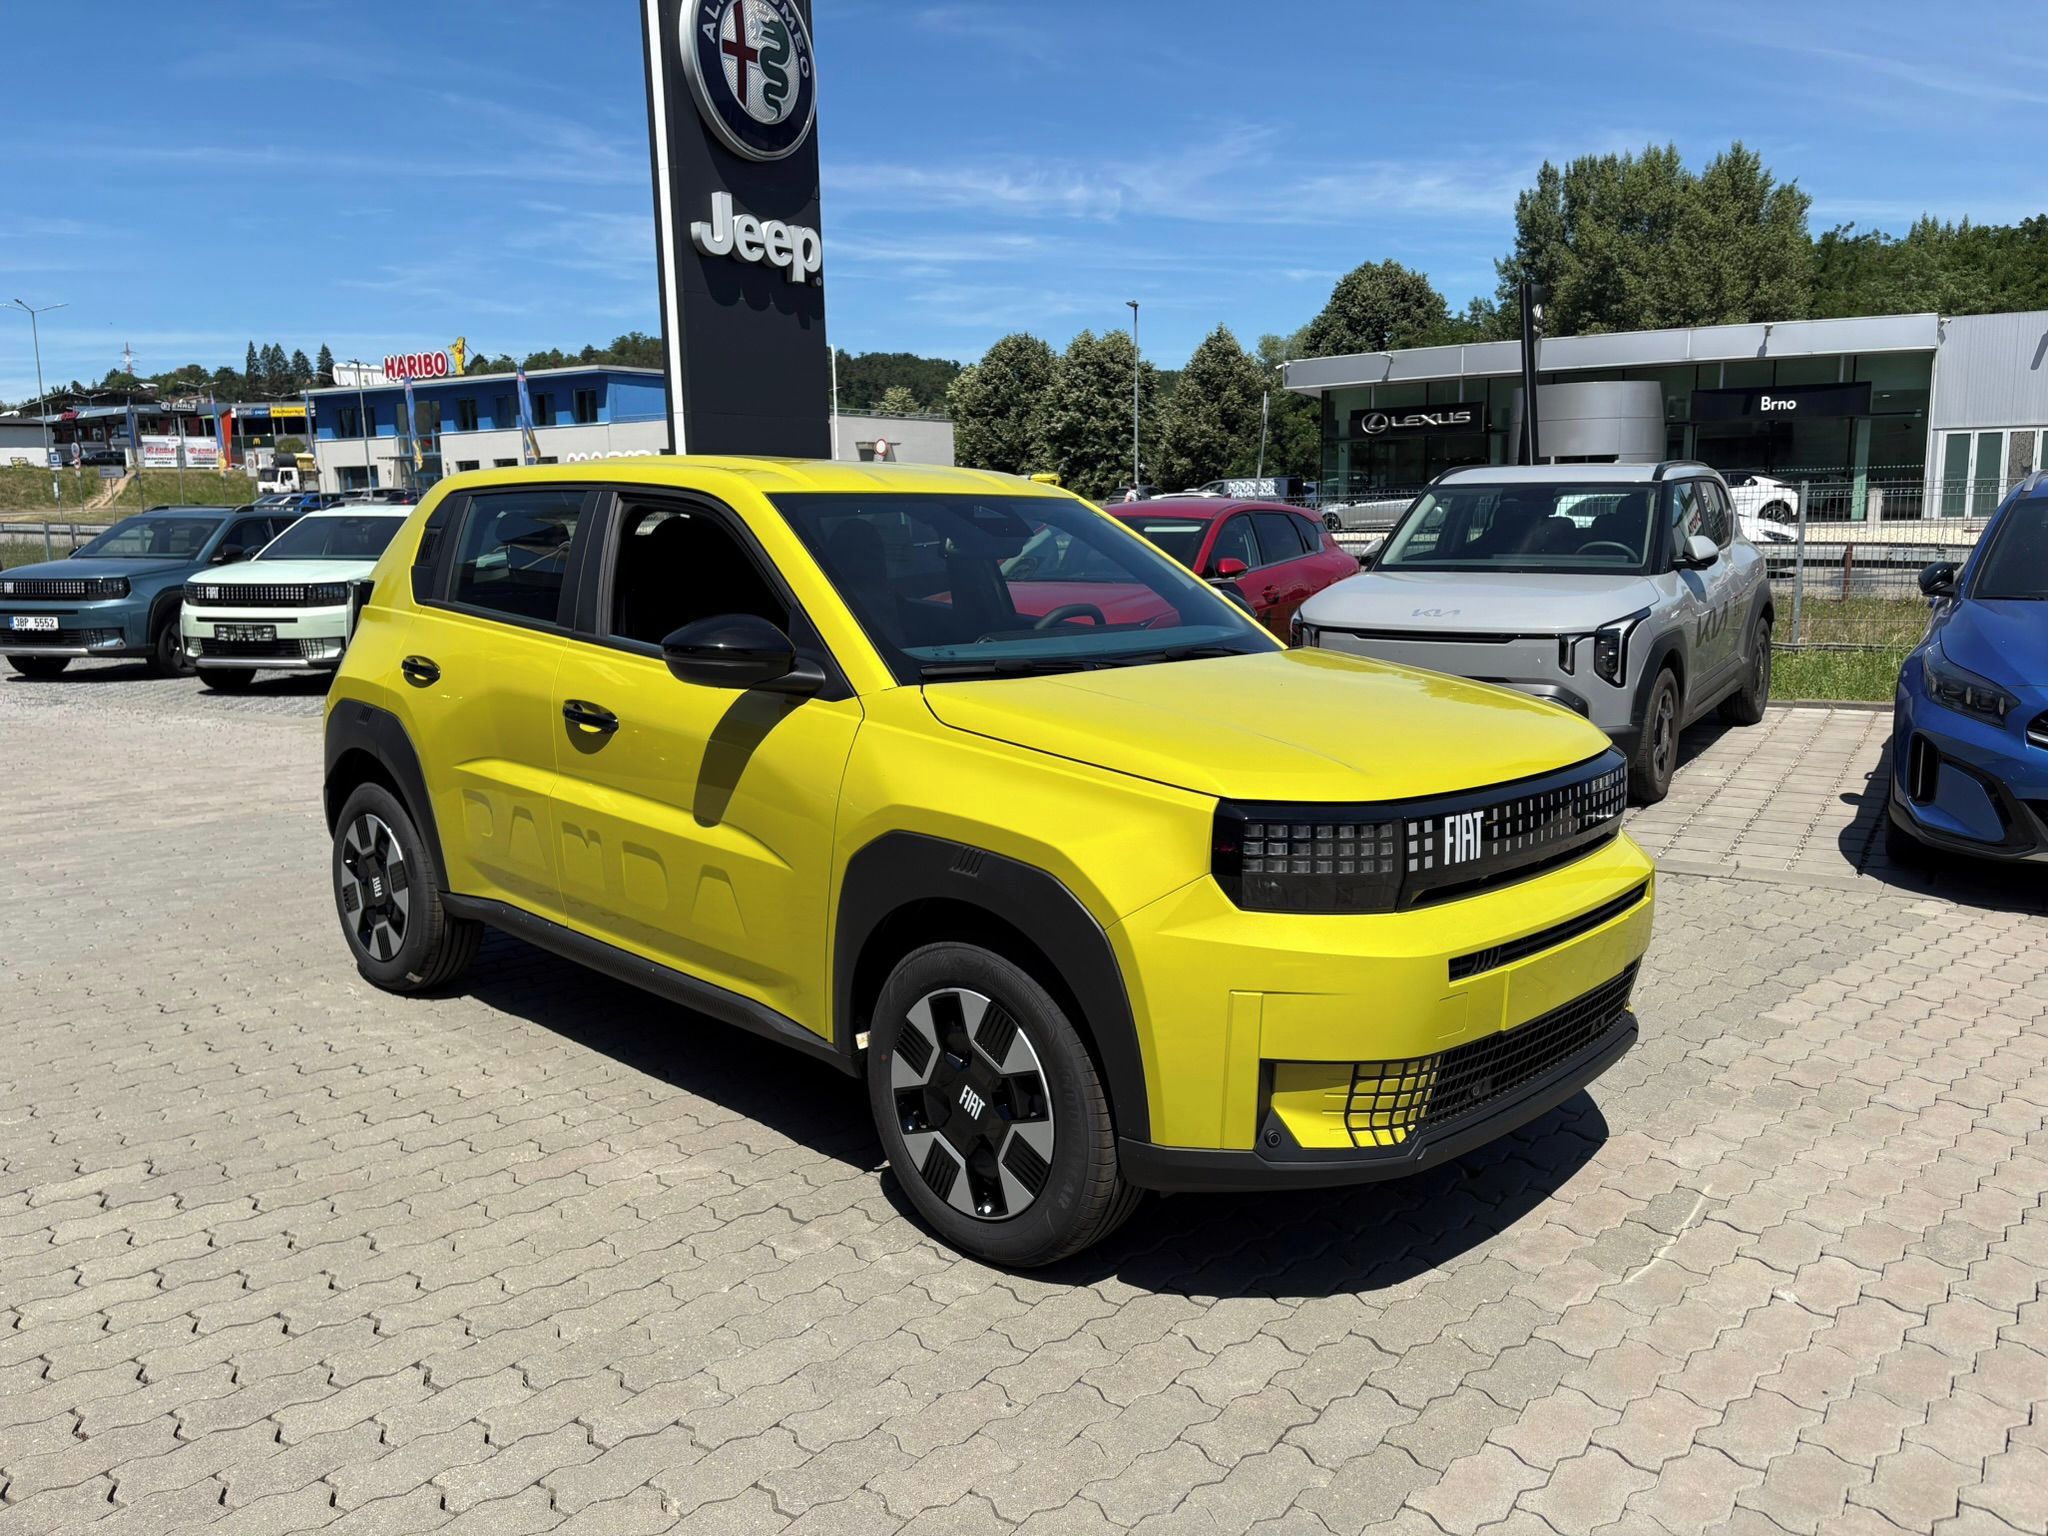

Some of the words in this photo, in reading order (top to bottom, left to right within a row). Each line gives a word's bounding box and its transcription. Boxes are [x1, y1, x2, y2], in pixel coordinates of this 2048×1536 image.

[691, 191, 822, 282] Jeep
[384, 351, 447, 379] HARIBO
[1761, 396, 1797, 411] Brno
[1391, 411, 1471, 427] LEXUS
[4, 582, 14, 593] FIAT
[206, 586, 219, 599] FIAT
[15, 617, 29, 627] 3BP
[34, 617, 55, 628] 5552
[1444, 811, 1484, 866] FIAT
[371, 876, 383, 898] FIAT
[958, 1084, 986, 1121] FIAT
